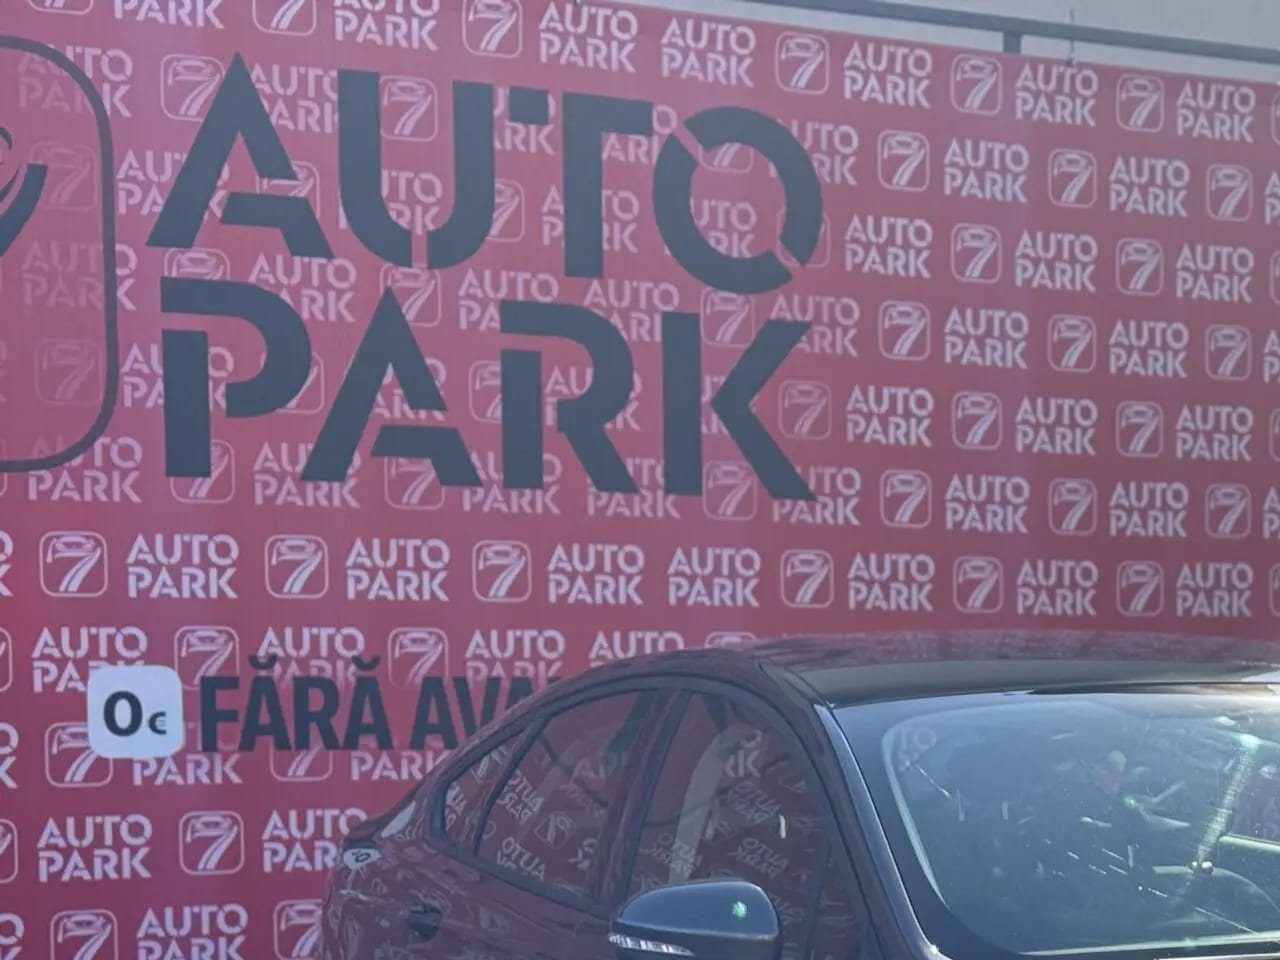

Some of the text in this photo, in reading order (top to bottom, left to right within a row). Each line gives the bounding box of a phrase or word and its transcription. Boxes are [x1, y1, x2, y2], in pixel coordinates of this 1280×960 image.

[334, 9, 440, 51] PARK
[539, 1, 635, 39] AUTO
[661, 17, 755, 54] AUTO
[540, 32, 635, 72] PARK
[662, 47, 753, 87] PARK
[844, 42, 932, 77] AUTO
[844, 69, 930, 108] PARK
[1015, 61, 1097, 96] AUTO
[1016, 91, 1096, 126] PARK
[1176, 82, 1256, 113] AUTO
[1177, 107, 1253, 143] PARK
[944, 138, 1029, 173] AUTO
[146, 52, 823, 294] AUTO
[944, 167, 1027, 203] PARK
[1109, 156, 1190, 188] AUTO
[1110, 183, 1187, 217] PARK
[845, 214, 933, 248] AUTO
[1015, 230, 1097, 262] AUTO
[248, 252, 357, 290] AUTO
[846, 243, 930, 278] PARK
[1016, 258, 1096, 292] PARK
[1176, 244, 1254, 274] AUTO
[458, 268, 559, 302] AUTO
[583, 278, 680, 312] AUTO
[1176, 270, 1252, 303] PARK
[944, 308, 1029, 339] AUTO
[1109, 320, 1189, 349] AUTO
[945, 335, 1027, 369] PARK
[1110, 347, 1187, 378] PARK
[160, 277, 818, 501] PARK
[846, 384, 934, 417] AUTO
[1016, 397, 1098, 426] AUTO
[1176, 405, 1253, 433] AUTO
[847, 414, 931, 446] PARK
[1016, 424, 1095, 455] PARK
[1176, 432, 1251, 461] PARK
[28, 467, 142, 505] PARK
[945, 474, 1030, 504] AUTO
[1109, 482, 1189, 509] AUTO
[946, 502, 1028, 533] PARK
[1110, 509, 1186, 537] PARK
[126, 534, 239, 565] AUTO
[346, 538, 450, 569] AUTO
[548, 543, 644, 574] AUTO
[668, 547, 760, 576] AUTO
[128, 566, 237, 598] PARK
[848, 552, 935, 582] AUTO
[1017, 560, 1098, 587] AUTO
[1176, 562, 1253, 589] AUTO
[347, 569, 448, 601] PARK
[549, 573, 643, 604] PARK
[669, 576, 759, 607] PARK
[849, 581, 933, 611] PARK
[1017, 587, 1096, 616] PARK
[1176, 588, 1251, 616] PARK
[32, 626, 148, 659] AUTO
[257, 626, 366, 658] AUTO
[465, 629, 566, 659] AUTO
[200, 654, 395, 753] FĂRĂ
[37, 814, 152, 848] AUTO
[39, 847, 151, 882] PARK
[137, 904, 248, 938] AUTO
